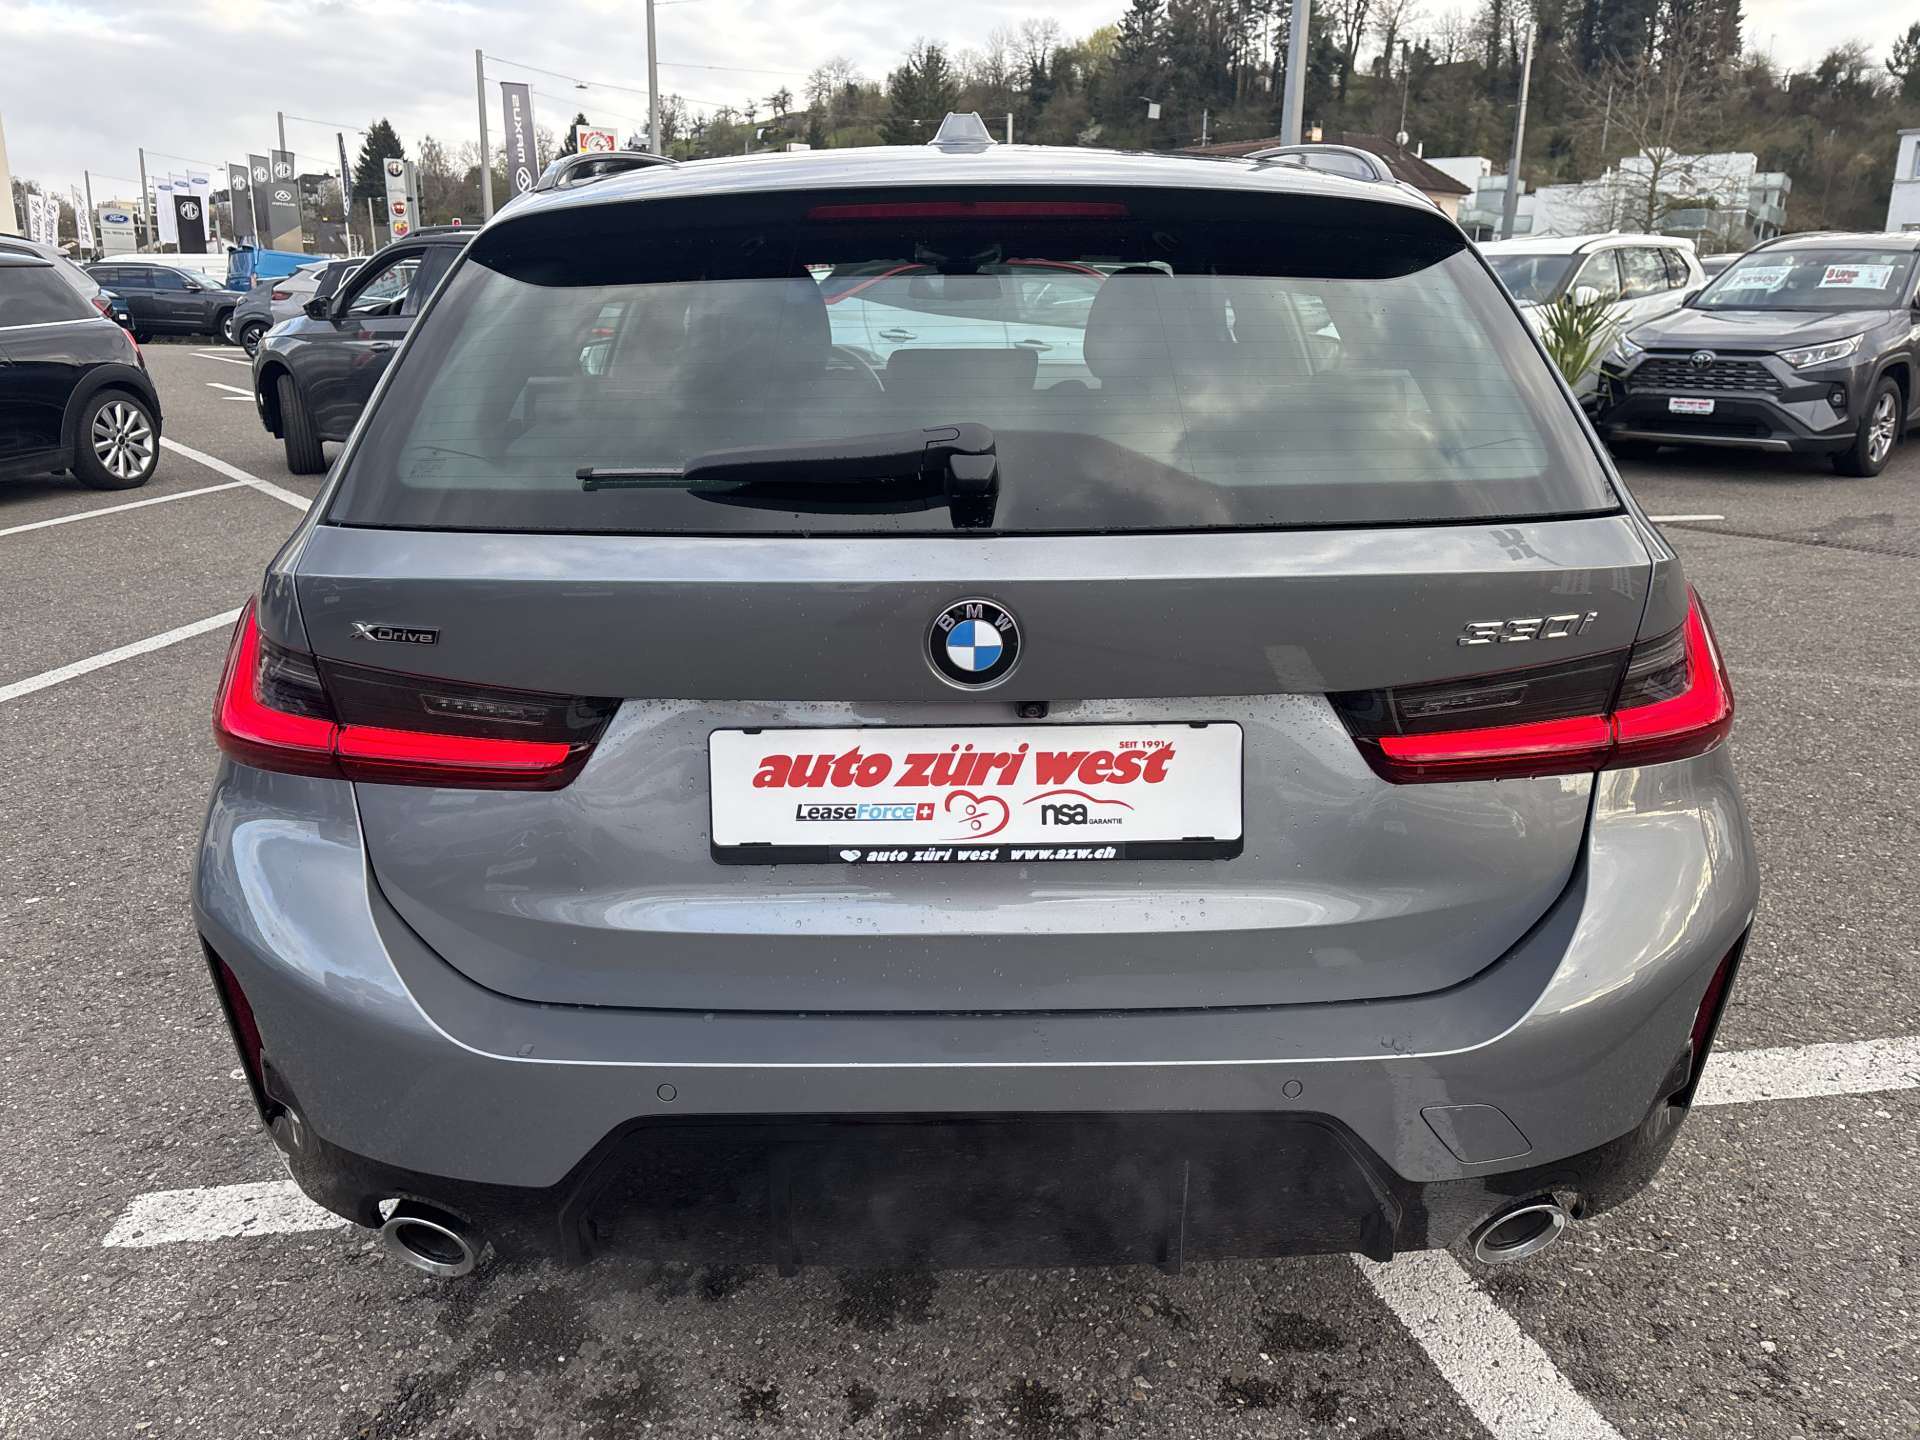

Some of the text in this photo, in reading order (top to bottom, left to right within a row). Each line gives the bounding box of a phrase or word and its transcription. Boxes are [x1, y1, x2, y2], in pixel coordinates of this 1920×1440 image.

[181, 202, 199, 220] MG
[937, 604, 1012, 632] BMW
[1456, 610, 1598, 645] 330i
[1119, 740, 1165, 749] SEIT 1991
[752, 741, 1176, 788] auto züri west
[796, 804, 915, 820] LeaseForce
[1041, 803, 1123, 825] nsa GARANTIE
[866, 846, 1117, 862] auto züri west www.azw.ch
